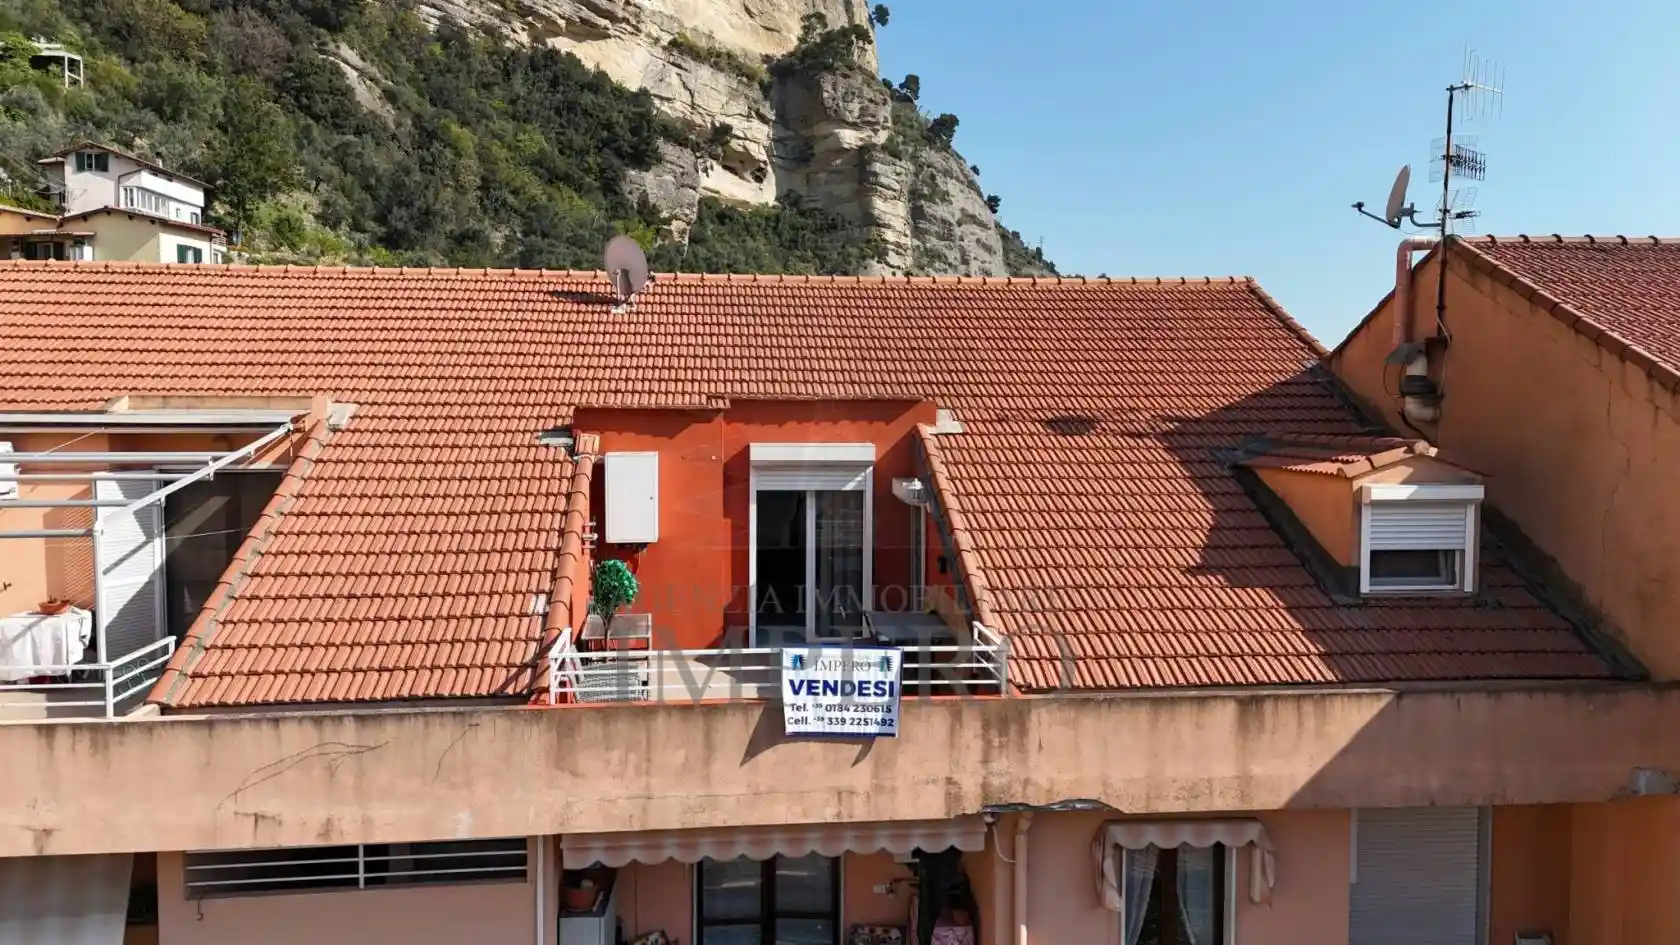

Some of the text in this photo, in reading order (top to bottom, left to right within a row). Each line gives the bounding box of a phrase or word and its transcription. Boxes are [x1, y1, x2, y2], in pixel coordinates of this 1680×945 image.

[814, 659, 872, 672] IMPERO
[788, 679, 894, 697] VENDESI
[790, 703, 809, 713] Tel.
[853, 704, 892, 714] 230615
[787, 716, 811, 726] Cell.
[827, 717, 847, 726] 339
[849, 717, 895, 727] 2251492
